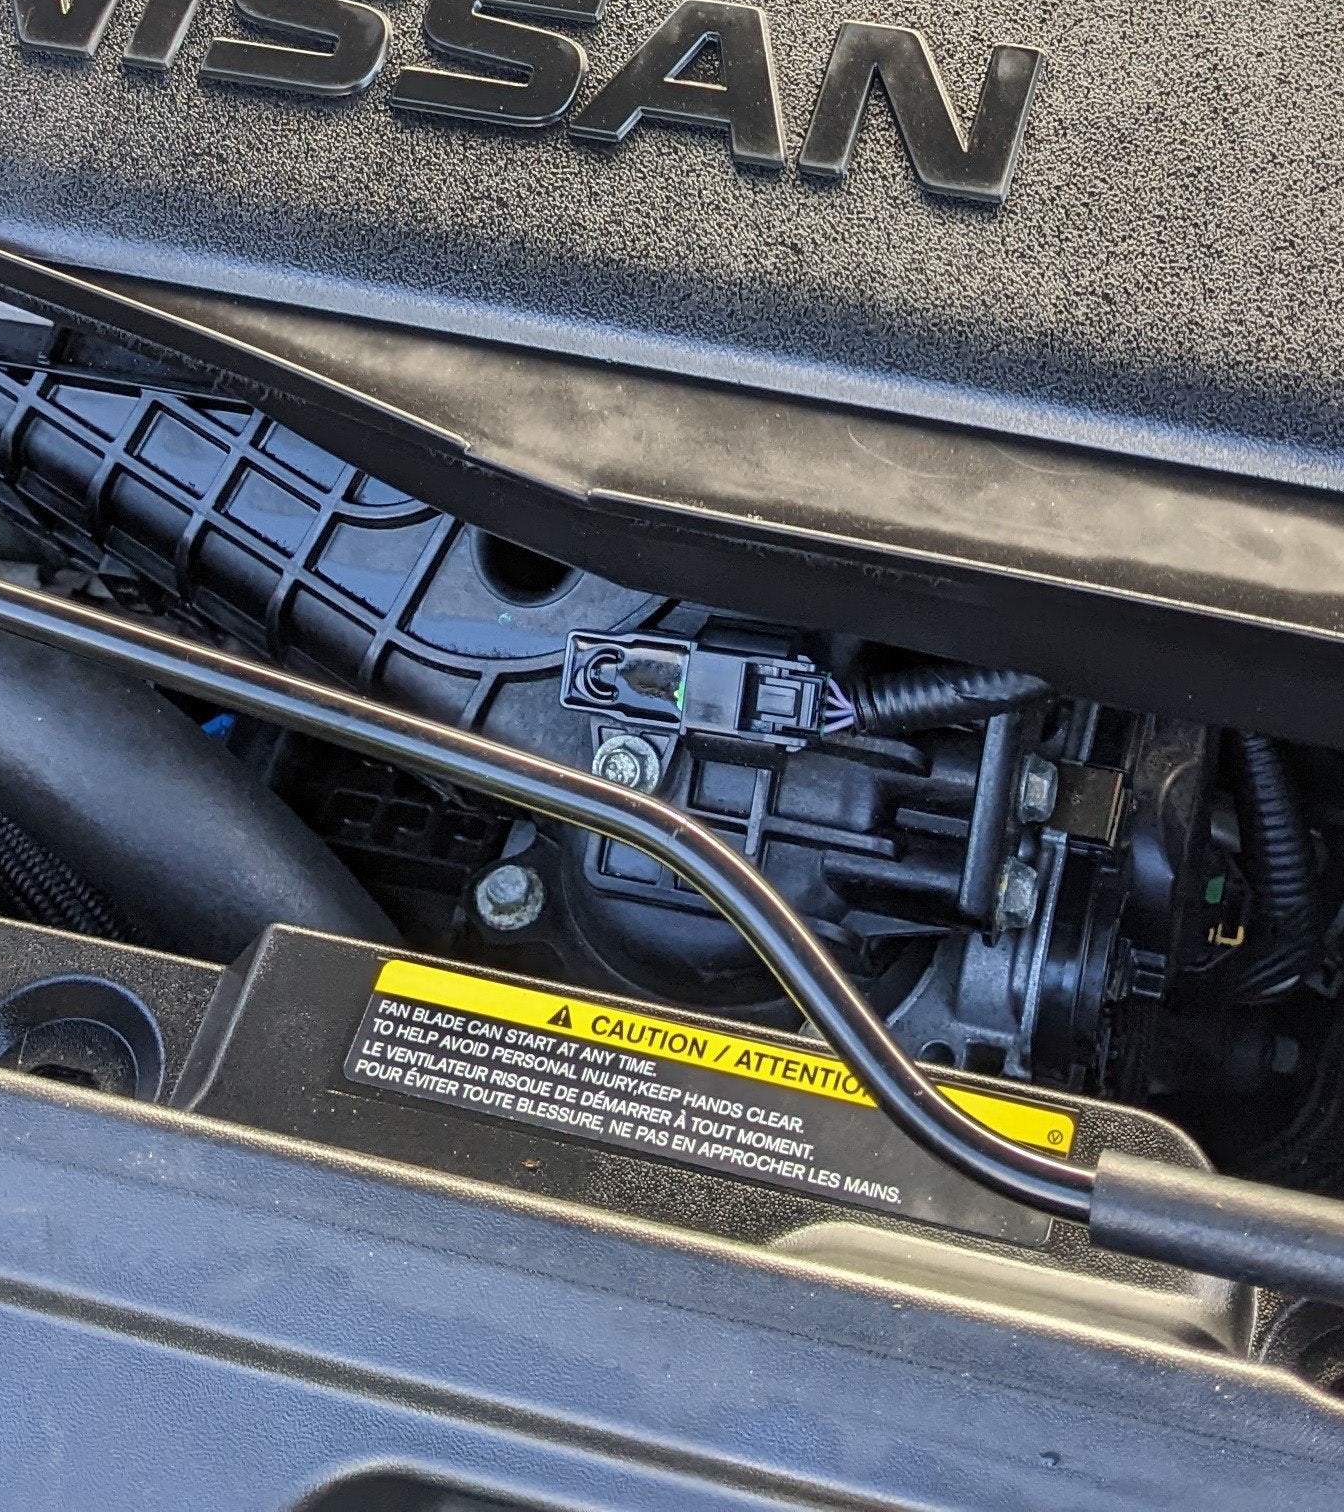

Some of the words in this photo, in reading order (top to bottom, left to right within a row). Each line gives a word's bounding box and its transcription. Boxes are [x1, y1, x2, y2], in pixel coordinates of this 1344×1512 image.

[373, 1018, 394, 1036] TO
[396, 1023, 440, 1045] HELP
[439, 1035, 490, 1059] AVOID
[492, 1048, 578, 1080] PERSONAL
[682, 1092, 744, 1119] HANDS
[746, 1107, 805, 1135] CLEAR.
[378, 999, 411, 1020] FAN
[412, 1008, 467, 1032] BLADE
[467, 1020, 504, 1041] CAN
[505, 1029, 557, 1053] START
[558, 1041, 580, 1058] AT
[579, 1047, 616, 1067] ANY
[619, 1054, 657, 1077] TIME.
[590, 1014, 708, 1060] CAUTION
[354, 1059, 404, 1083] POUR
[404, 1067, 459, 1096] ÉVITER
[462, 1084, 515, 1110] TOUTE
[516, 1097, 605, 1135] BLESSURE,
[609, 1119, 633, 1139] NE
[635, 1126, 668, 1148] PAS
[671, 1134, 697, 1155] EN
[697, 1141, 806, 1181] APPROCHER
[808, 1167, 841, 1189] LES
[843, 1177, 903, 1204] MAINS.
[362, 1039, 382, 1057] LE
[385, 1044, 489, 1082] VENTILATEUR
[492, 1069, 553, 1096] RISQUE
[554, 1084, 580, 1103] DE
[580, 1089, 671, 1127] DÉMARRER
[673, 1108, 688, 1129] À
[691, 1117, 736, 1141] TOUT
[736, 1129, 815, 1162] MOMENT.
